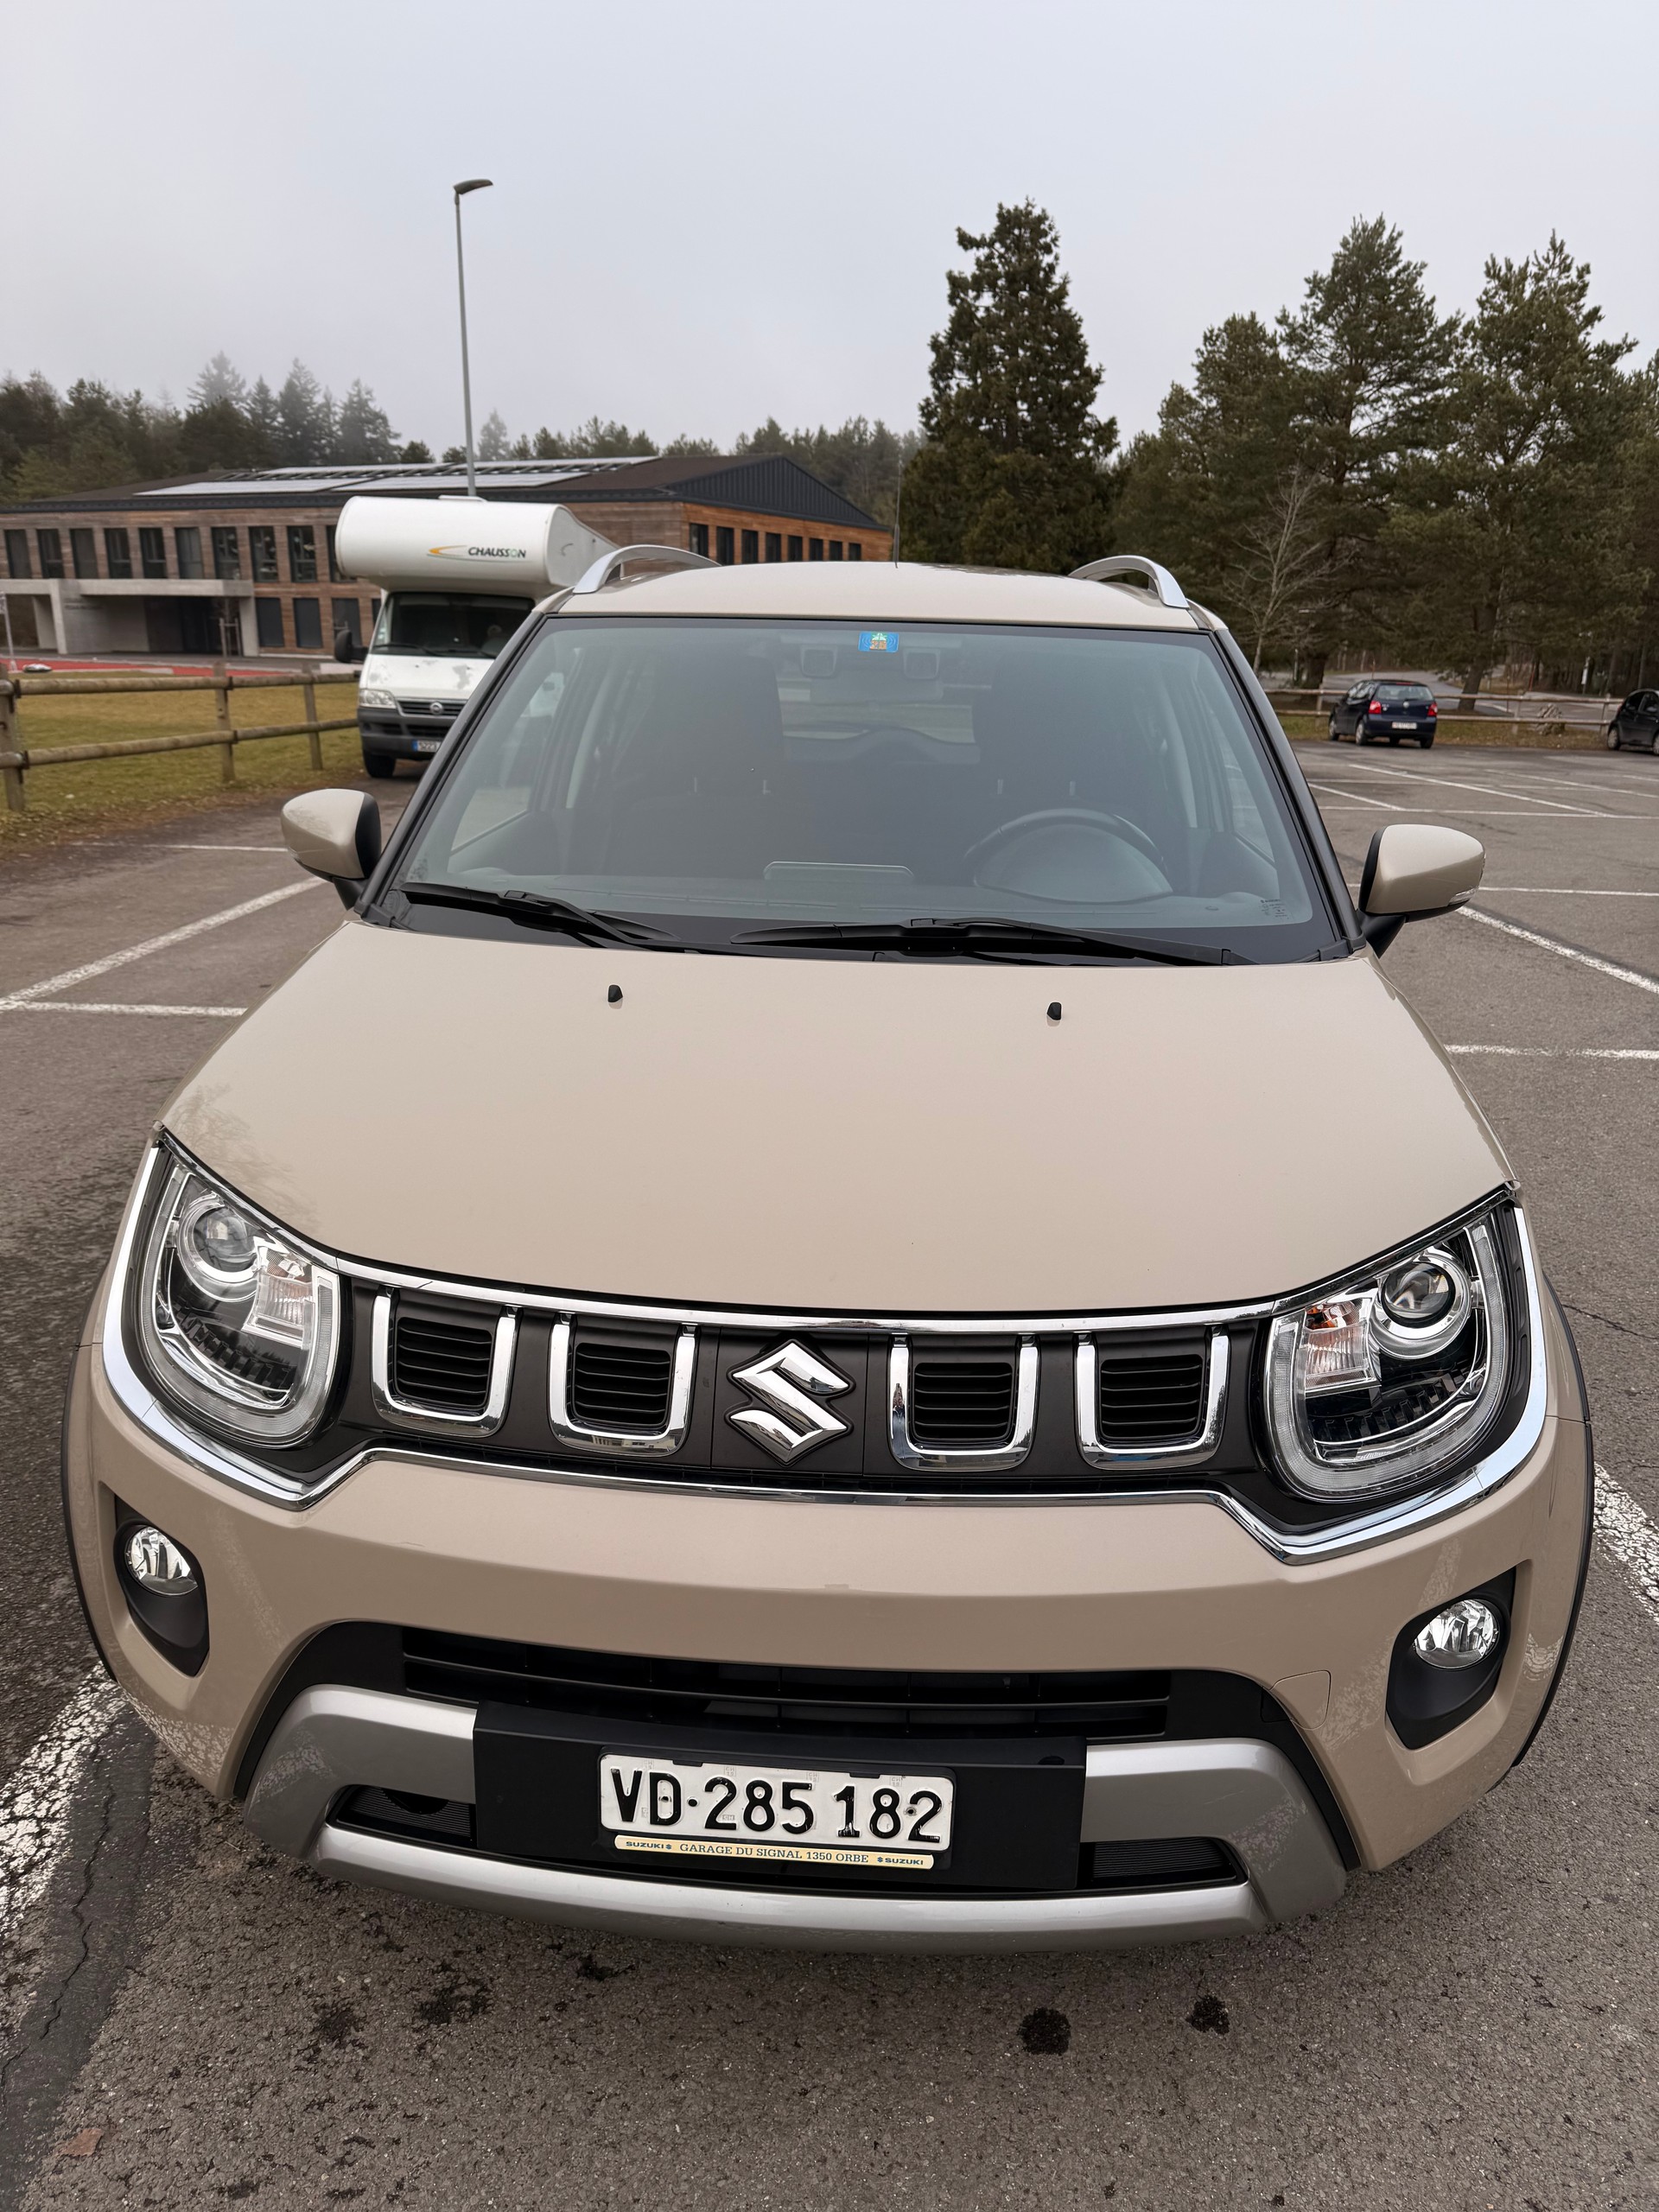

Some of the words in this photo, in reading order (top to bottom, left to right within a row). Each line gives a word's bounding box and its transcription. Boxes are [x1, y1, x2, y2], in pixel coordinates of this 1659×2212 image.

[467, 546, 527, 558] CHAUSSON
[833, 1785, 942, 1843] 182
[679, 1843, 733, 1854] GARAGE
[735, 1846, 753, 1856] DU
[756, 1848, 802, 1859] SIGNAL
[806, 1852, 832, 1861] 1350
[836, 1853, 869, 1863] ORBE
